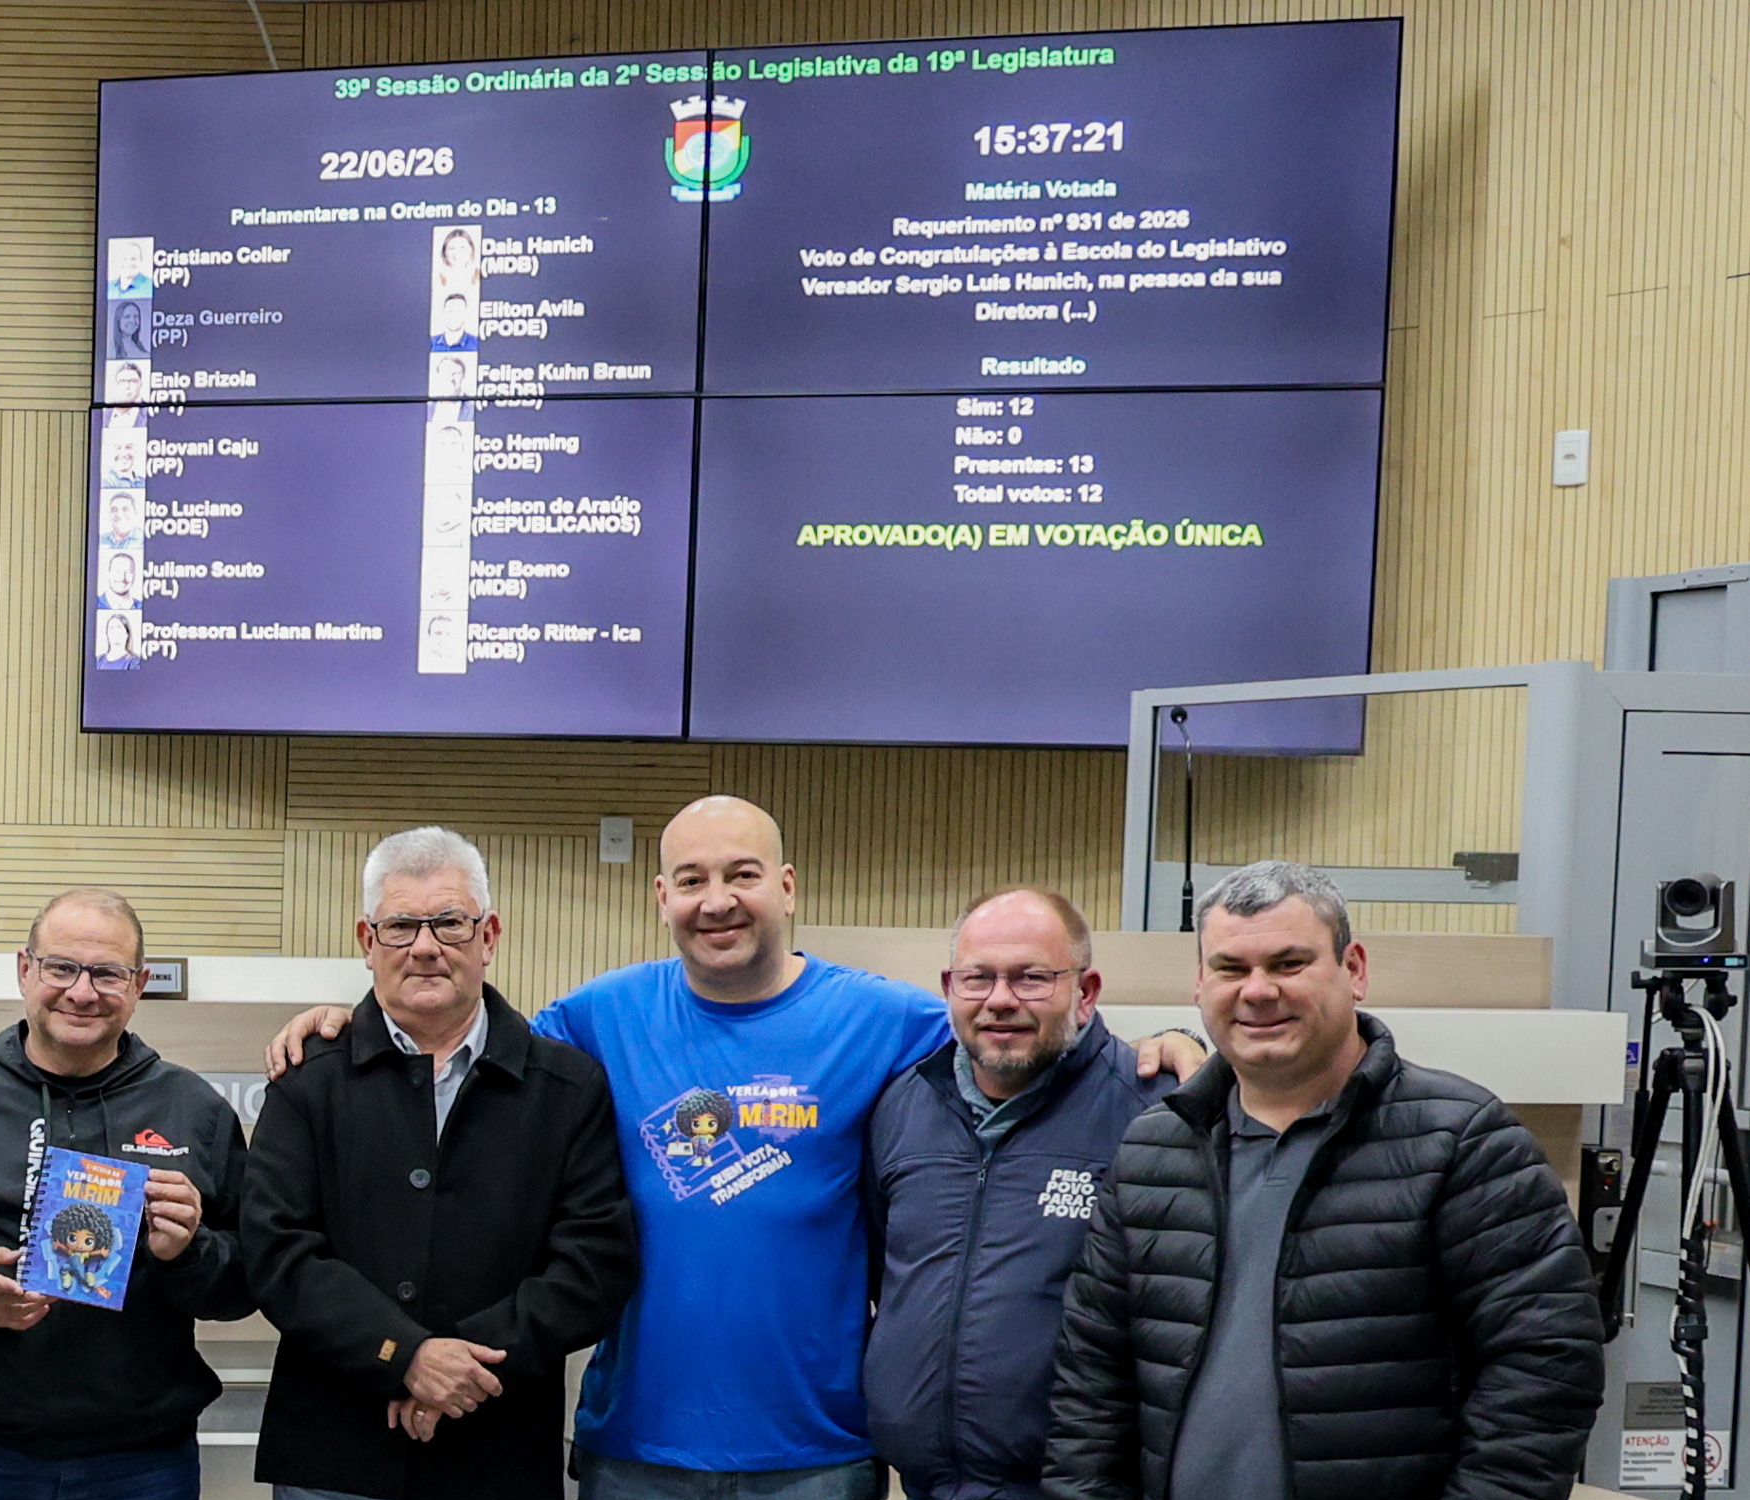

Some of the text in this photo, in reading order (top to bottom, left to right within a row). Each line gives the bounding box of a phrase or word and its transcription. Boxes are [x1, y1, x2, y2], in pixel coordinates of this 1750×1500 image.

[335, 46, 1114, 98] 39ª Sessão Ordinária da 2ª Sessão Legislativa da 19ª Legislatura
[974, 121, 1124, 155] 15:37:21
[320, 147, 454, 181] 22/06/26
[965, 180, 1117, 201] Matéria Votada
[231, 197, 557, 225] Parlamentares na Ordem do Dia 13
[893, 211, 1189, 239] Requerimento nº 931 de 2026
[482, 236, 594, 255] Daia Hanich
[800, 238, 1286, 268] Voto de Congratulações à Escola do Legislativo
[154, 246, 290, 266] Cristiano Coller
[481, 255, 539, 277] (MDB)
[153, 267, 190, 287] (PP)
[802, 269, 1281, 299] Vereador Sergio Luis Hanich, na pessoa da sua
[152, 307, 283, 327] Deza Guerreiro
[480, 300, 585, 318] Eliton Avila
[976, 300, 1097, 322] Diretora (...)
[152, 328, 188, 347] (PP)
[479, 318, 547, 339] (PODE)
[478, 362, 651, 384] Felipe Kuhn Braun
[981, 358, 1086, 376] Resultado
[151, 370, 256, 389] Enio Brizola
[956, 398, 1033, 416] Sim: 12
[474, 434, 502, 453] Ico
[956, 427, 1022, 445] Não: 0
[146, 439, 258, 459] Giovani Caju
[146, 457, 184, 477] (PP)
[474, 453, 542, 473] (PODE)
[955, 456, 1093, 474] Presentes: 13
[954, 484, 1103, 503] Total votos: 12
[146, 500, 242, 518] Ito Luciano
[472, 494, 641, 517] Joelson de Araújo
[145, 518, 208, 538] (PODE)
[472, 515, 641, 536] (REPUBLICANOS)
[797, 518, 1262, 550] APROVADO(A) EM VOTAÇÃO ÚNICA
[144, 561, 264, 579] Juliano Souto
[471, 560, 570, 578] Nor Boeno
[143, 578, 178, 599] (PL)
[470, 578, 526, 599] (MDB)
[142, 622, 383, 642] Professora Luciana Martins
[468, 624, 540, 642] Ricardo
[545, 624, 597, 642] Ritter
[142, 640, 176, 660] (PT)
[468, 641, 524, 662] (MDB)
[727, 1086, 798, 1098] VEREADOR
[710, 1160, 744, 1189] QUEM
[710, 1151, 792, 1206] TRANSFORMA!
[1051, 1169, 1092, 1183] PELO
[1046, 1181, 1095, 1195] POVO
[1038, 1193, 1084, 1206] PARA
[1043, 1204, 1091, 1220] POVO
[1625, 1435, 1669, 1448] ATENÇÃO
